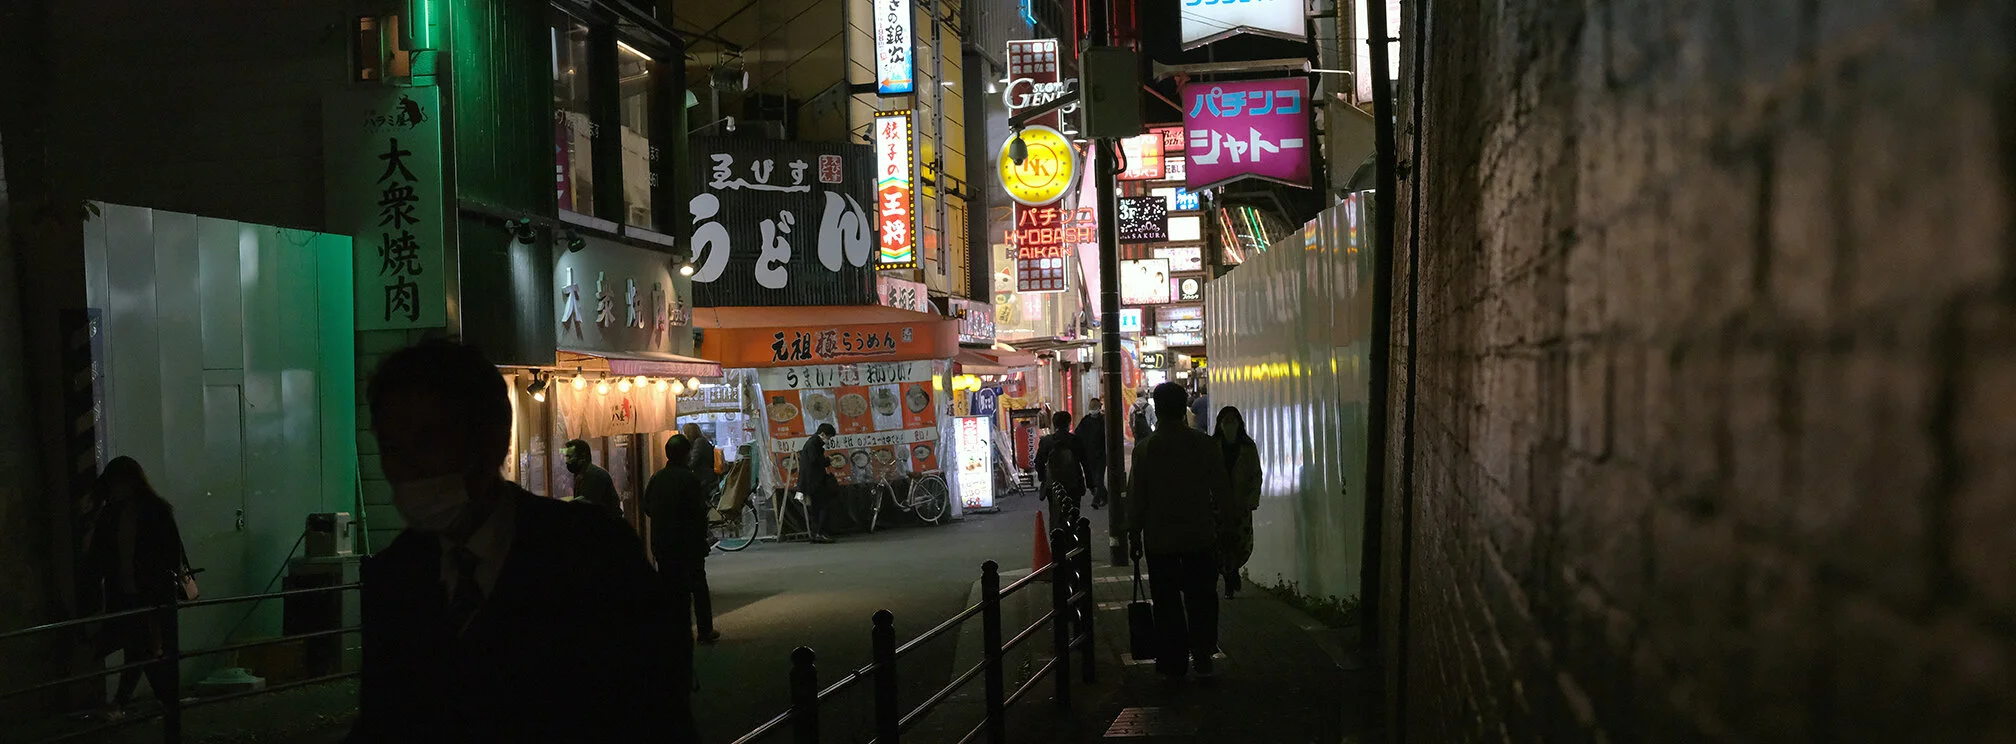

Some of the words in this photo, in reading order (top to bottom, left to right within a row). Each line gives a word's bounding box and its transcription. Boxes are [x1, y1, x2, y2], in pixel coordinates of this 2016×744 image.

[1189, 86, 1301, 119] パチンコ
[1189, 127, 1304, 165] シャトー
[1019, 206, 1095, 227] パチンコ
[1119, 204, 1137, 220] 3F
[377, 137, 424, 322] 大衆焼肉
[689, 190, 871, 289] うどん
[1004, 227, 1096, 246] KYOBASHI
